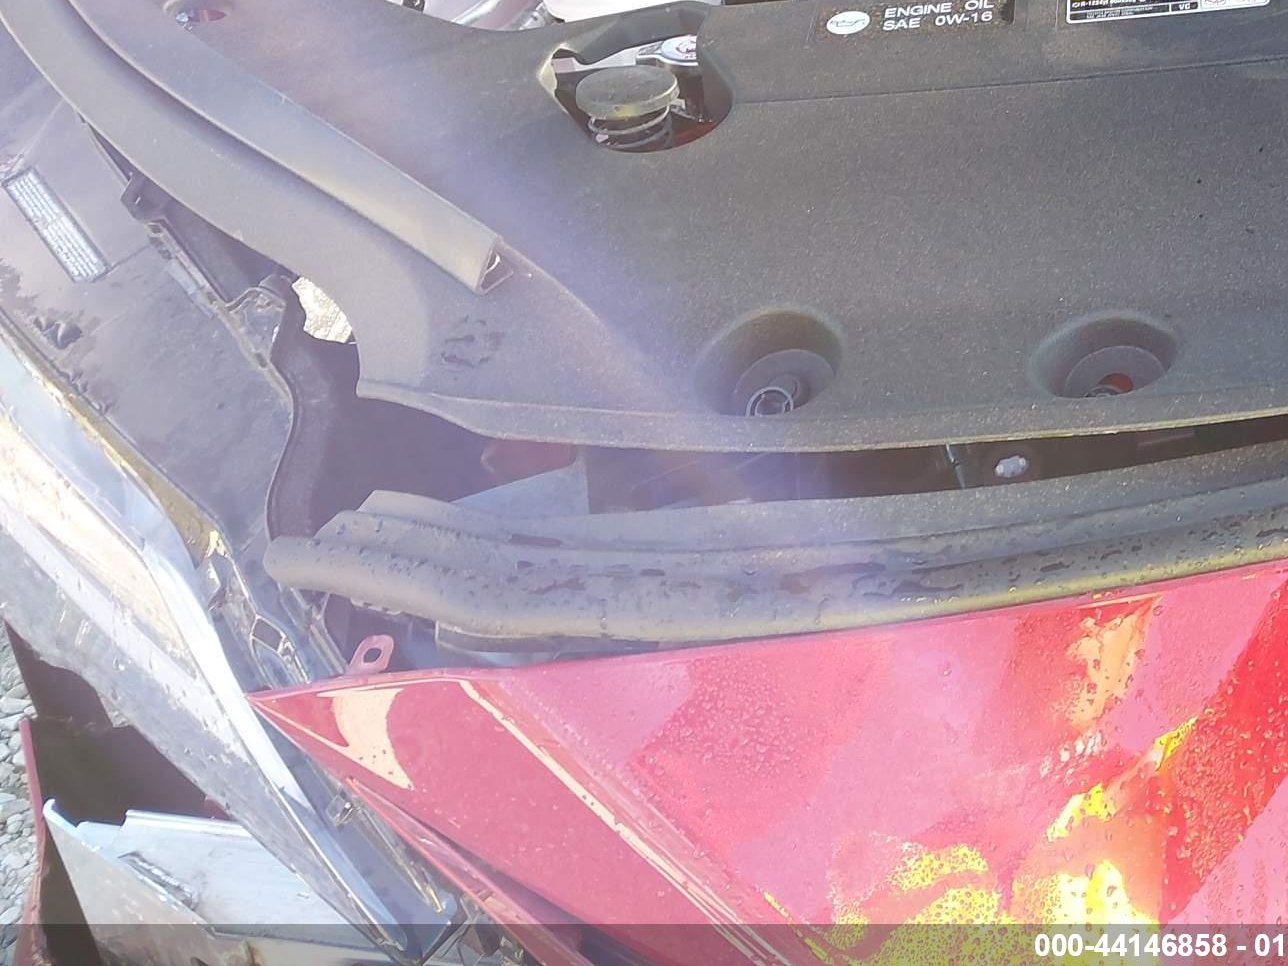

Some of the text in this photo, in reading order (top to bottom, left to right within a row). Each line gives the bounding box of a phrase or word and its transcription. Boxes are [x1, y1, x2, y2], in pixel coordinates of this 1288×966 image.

[884, 2, 953, 19] ENGINE
[882, 11, 993, 31] SAE 0W-16
